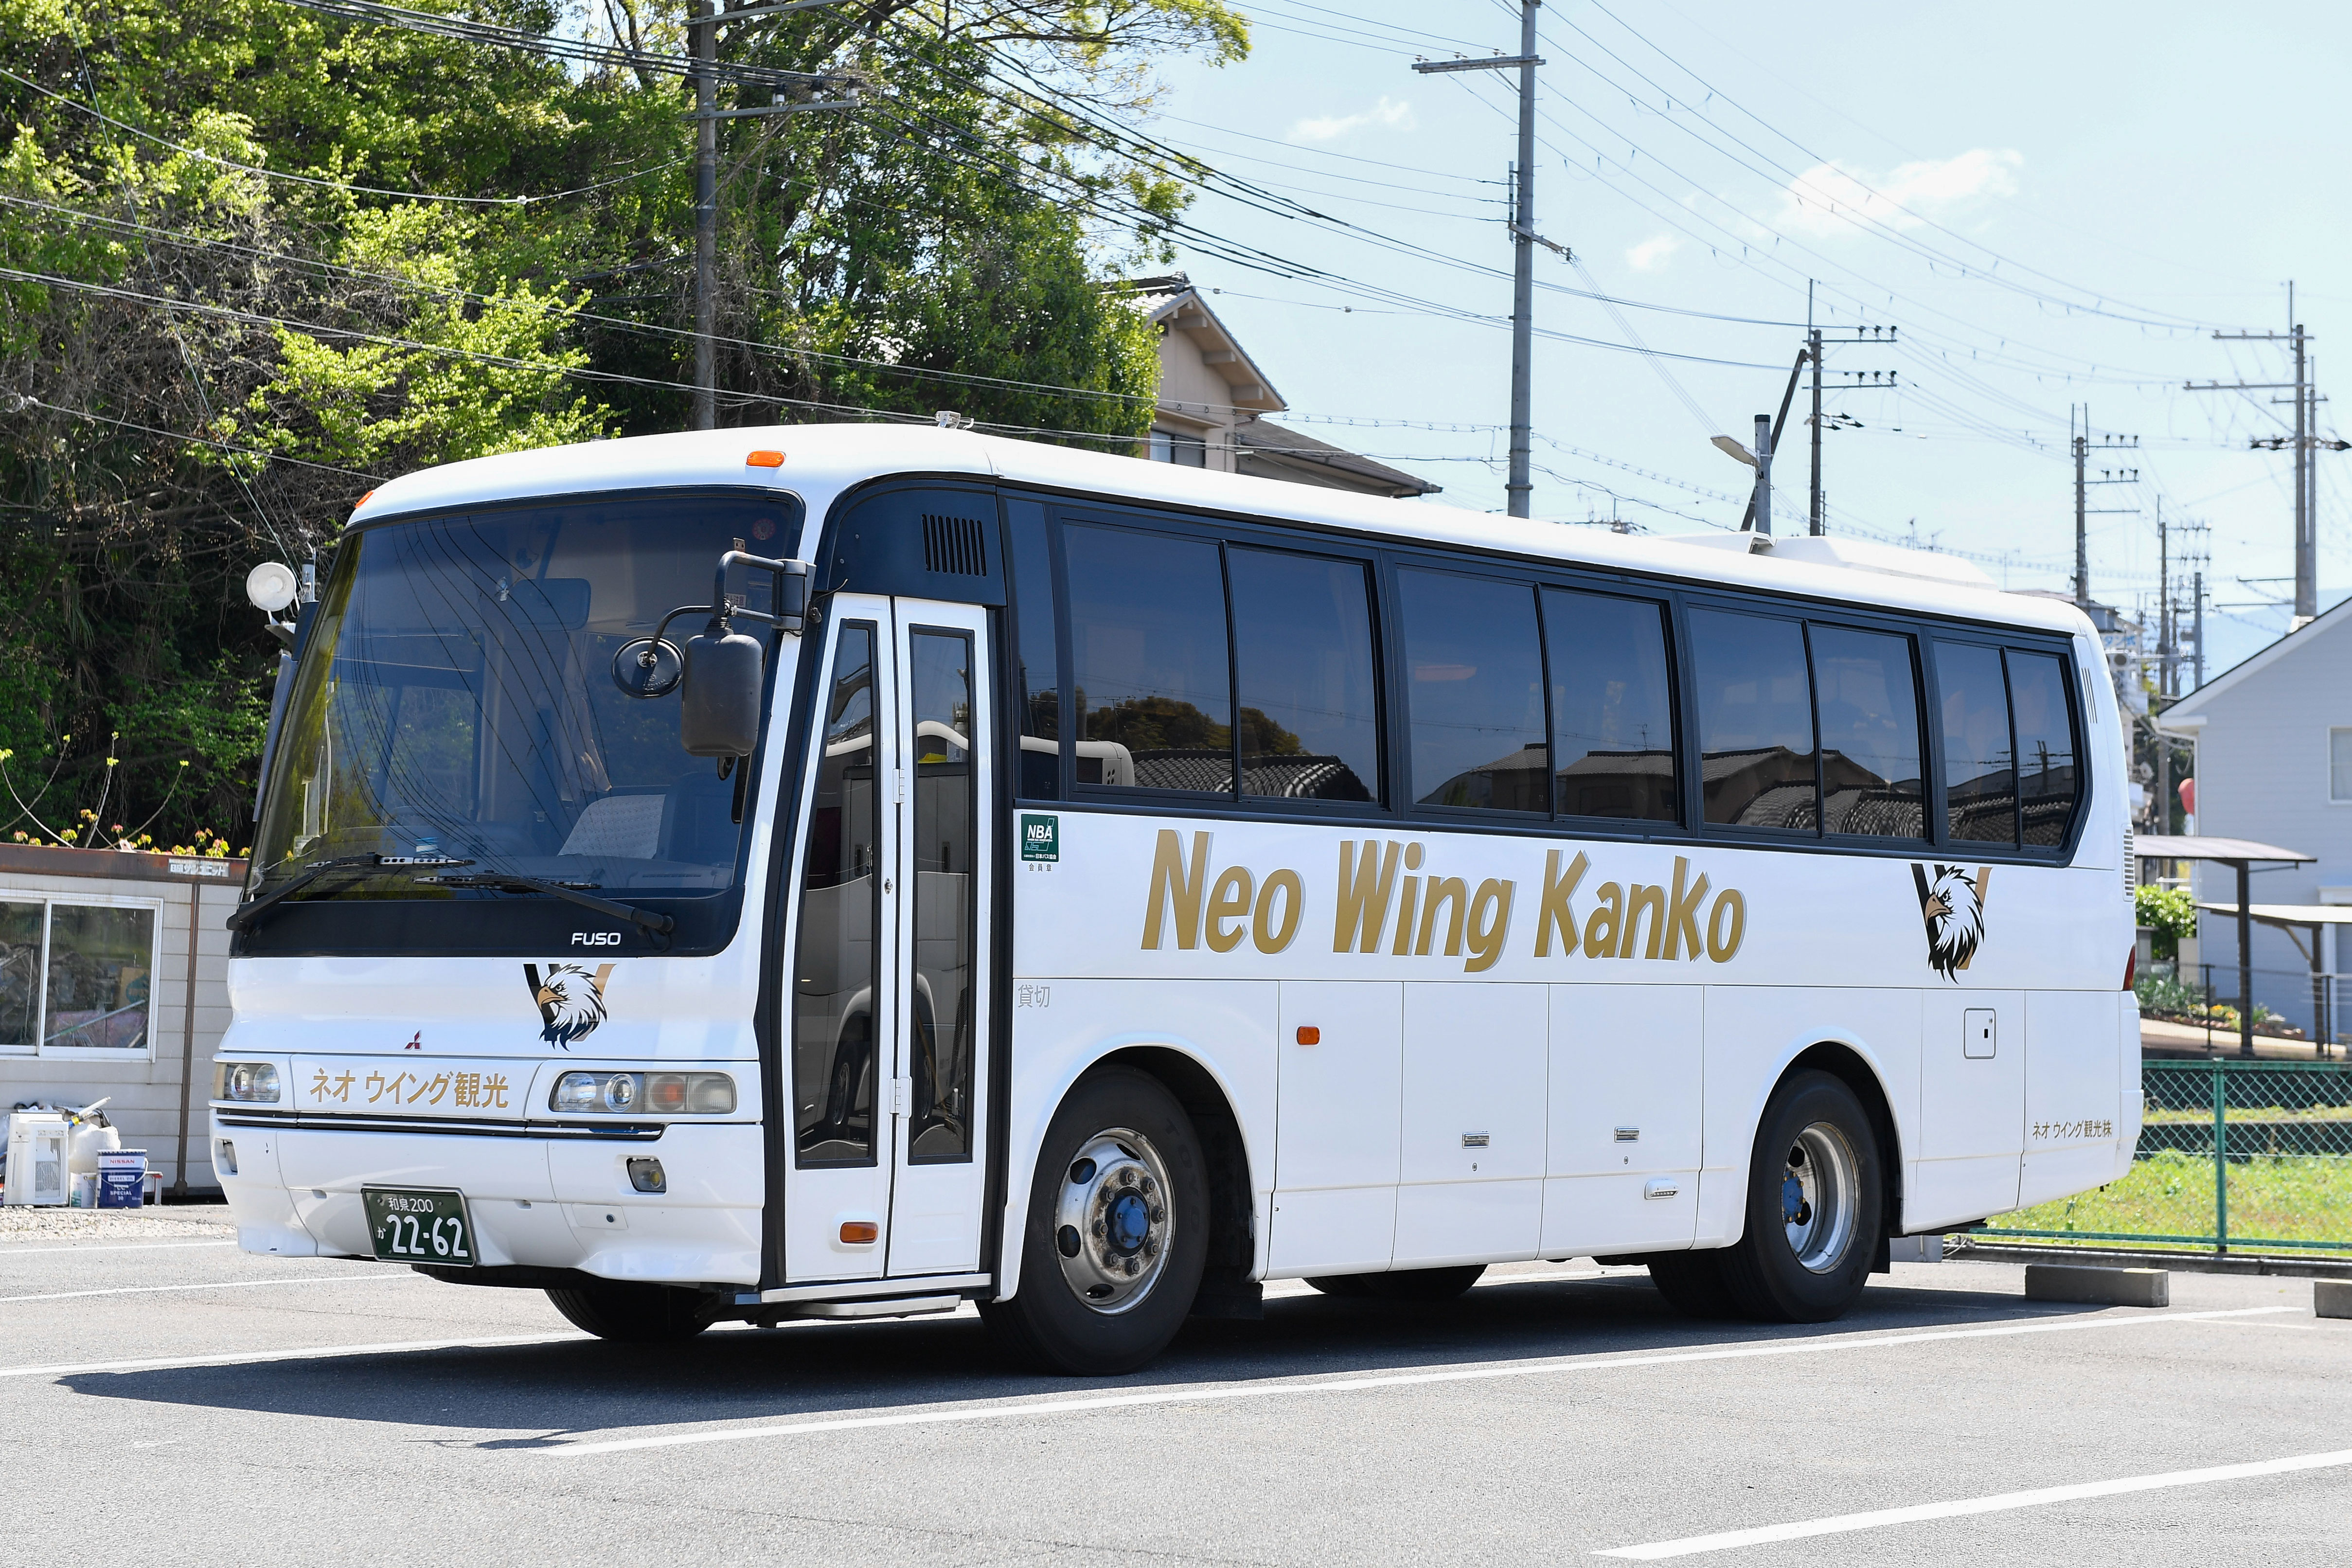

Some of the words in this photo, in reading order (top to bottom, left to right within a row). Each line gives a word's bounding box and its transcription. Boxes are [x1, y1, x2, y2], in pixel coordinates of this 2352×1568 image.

[1027, 824, 1052, 839] NBA
[1029, 863, 1051, 872] 会員章
[1140, 829, 1306, 955] Neo
[1333, 839, 1517, 973] Wing
[1533, 849, 1747, 963] Kanko
[571, 932, 621, 945] FUSO
[1018, 984, 1050, 1008] 貸切
[377, 1227, 386, 1239] か
[386, 1214, 468, 1257] 22-62
